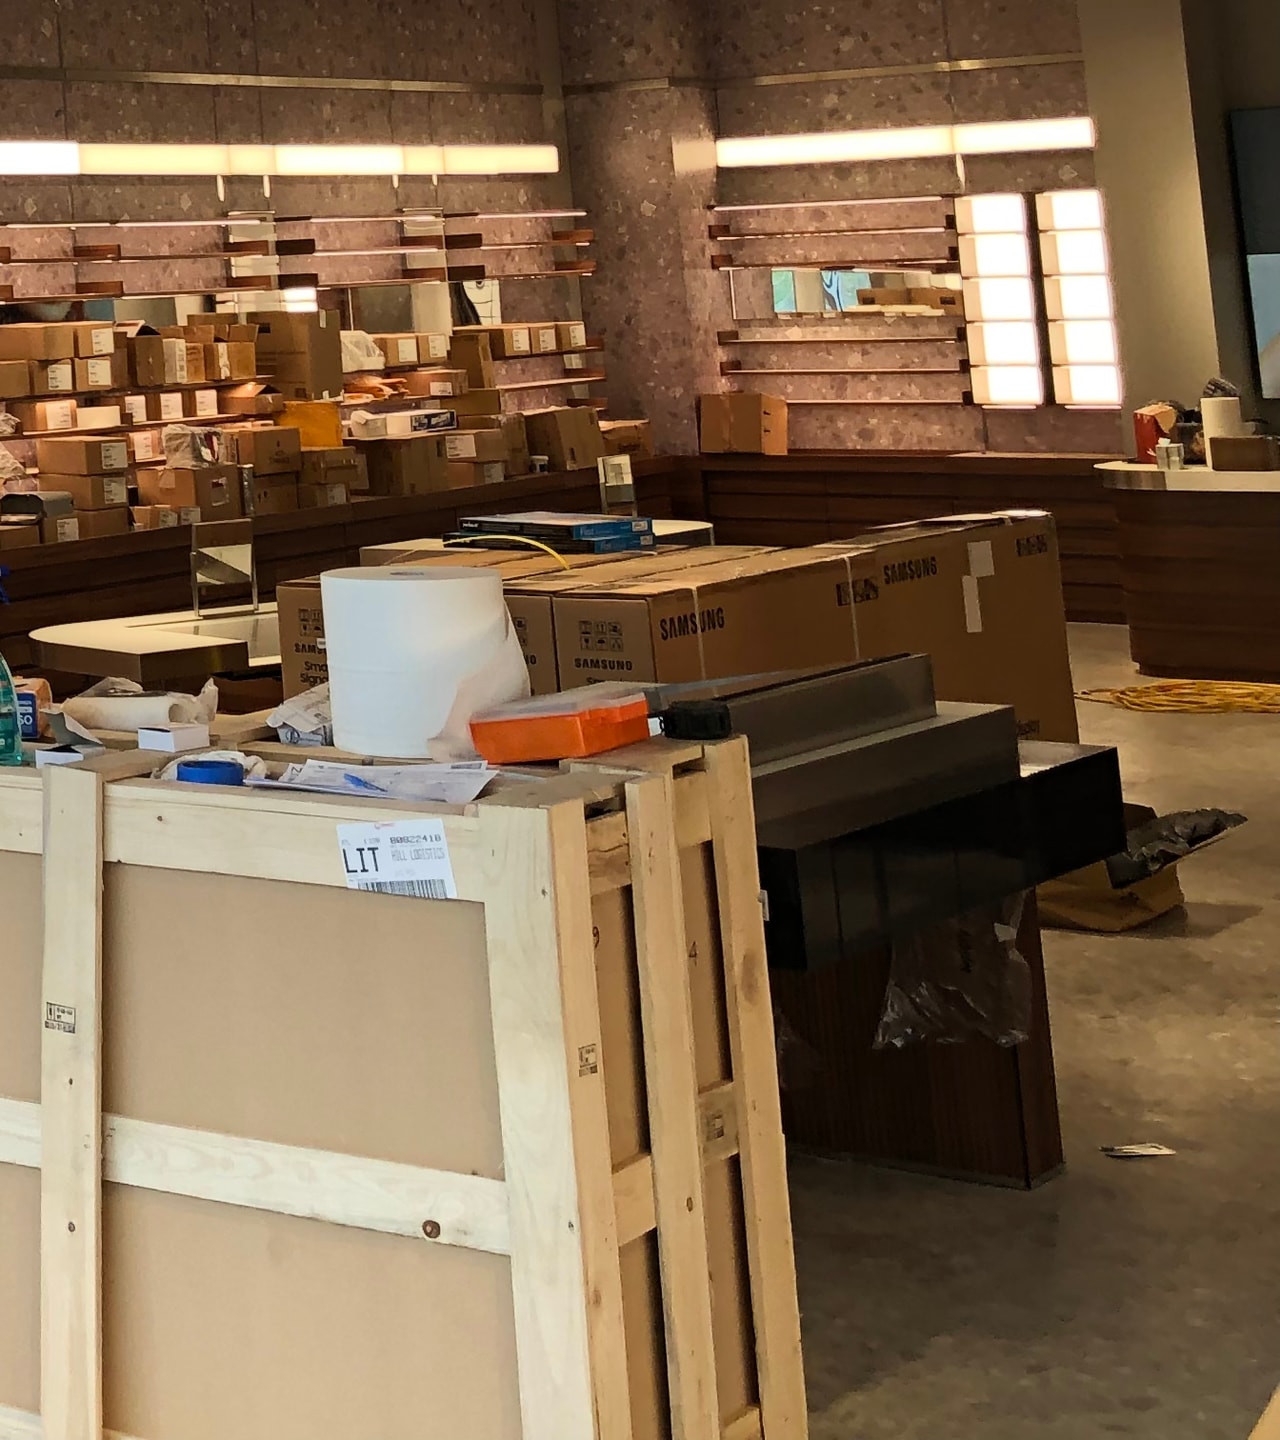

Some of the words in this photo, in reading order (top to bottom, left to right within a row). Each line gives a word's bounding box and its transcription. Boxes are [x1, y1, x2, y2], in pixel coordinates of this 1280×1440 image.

[883, 556, 938, 585] SAMSUNG
[659, 607, 726, 642] SAMSUNG
[574, 657, 633, 671] SAMSUNG
[342, 846, 379, 873] LIT
